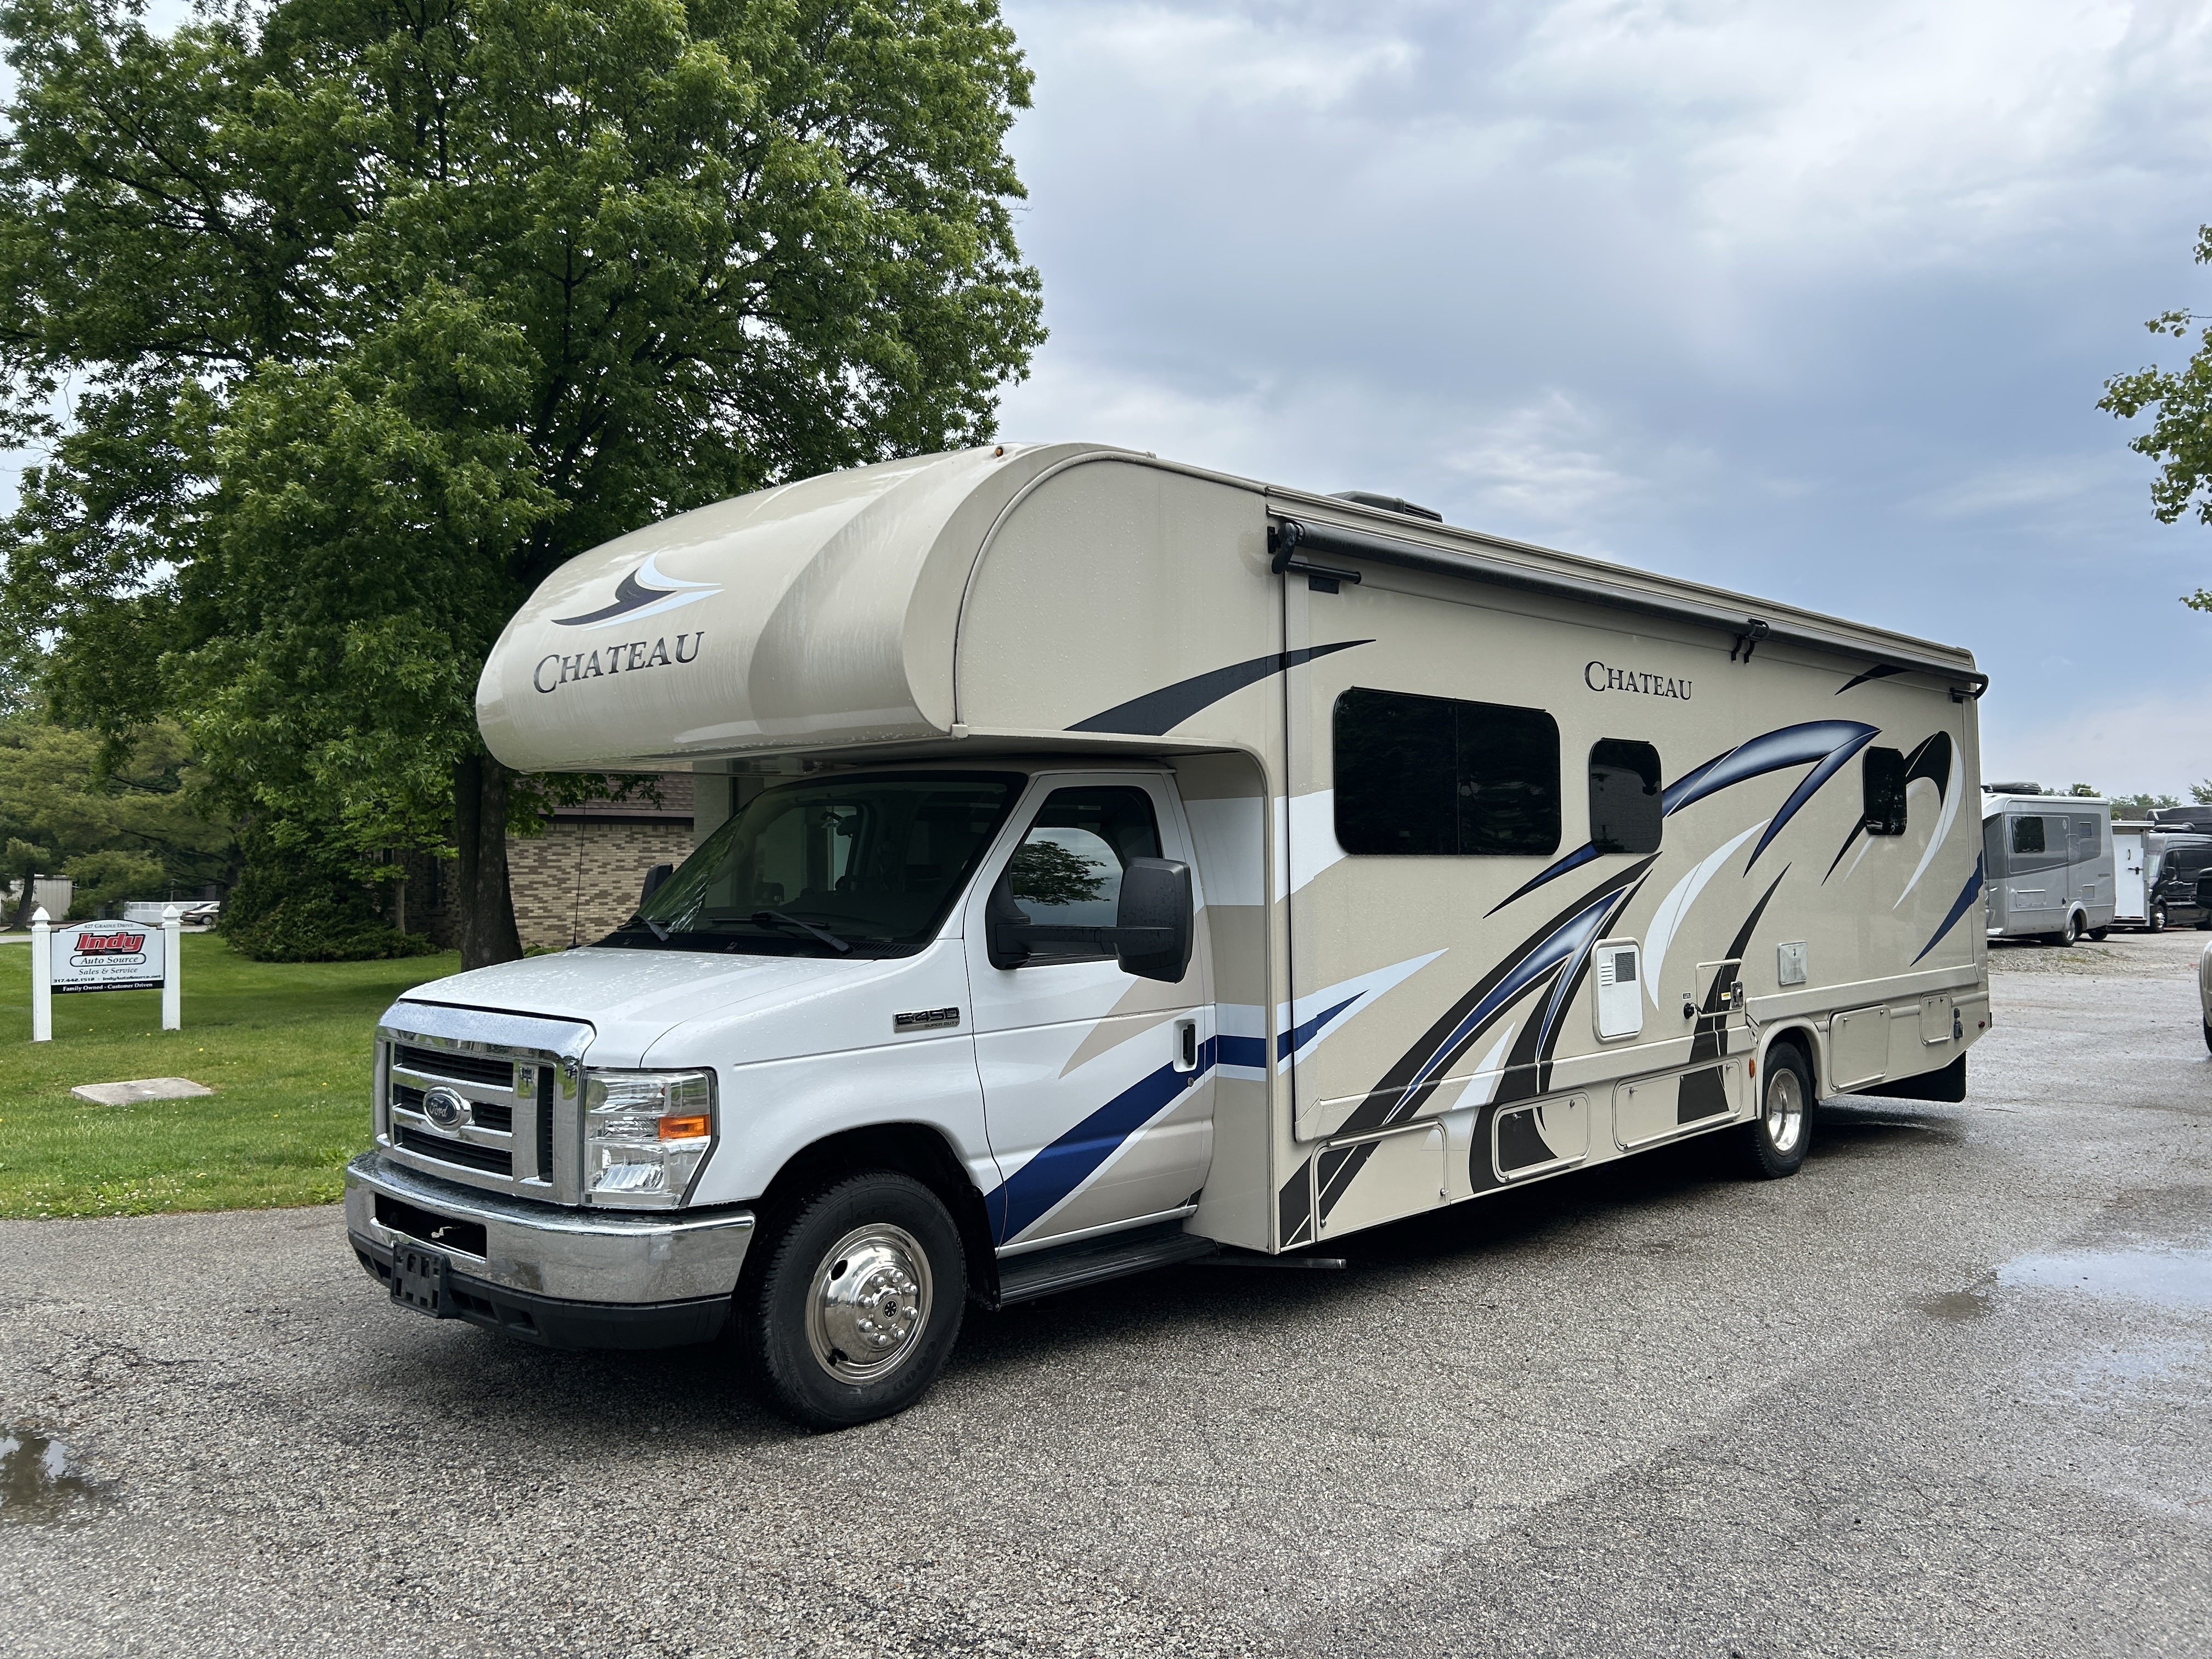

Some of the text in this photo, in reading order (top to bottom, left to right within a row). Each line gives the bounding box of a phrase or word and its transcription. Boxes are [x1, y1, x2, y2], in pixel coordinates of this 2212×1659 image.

[533, 631, 704, 693] CHATEAU
[1584, 661, 1692, 701] CHATEAU
[75, 933, 144, 952] Indy
[429, 1097, 448, 1118] Ford
